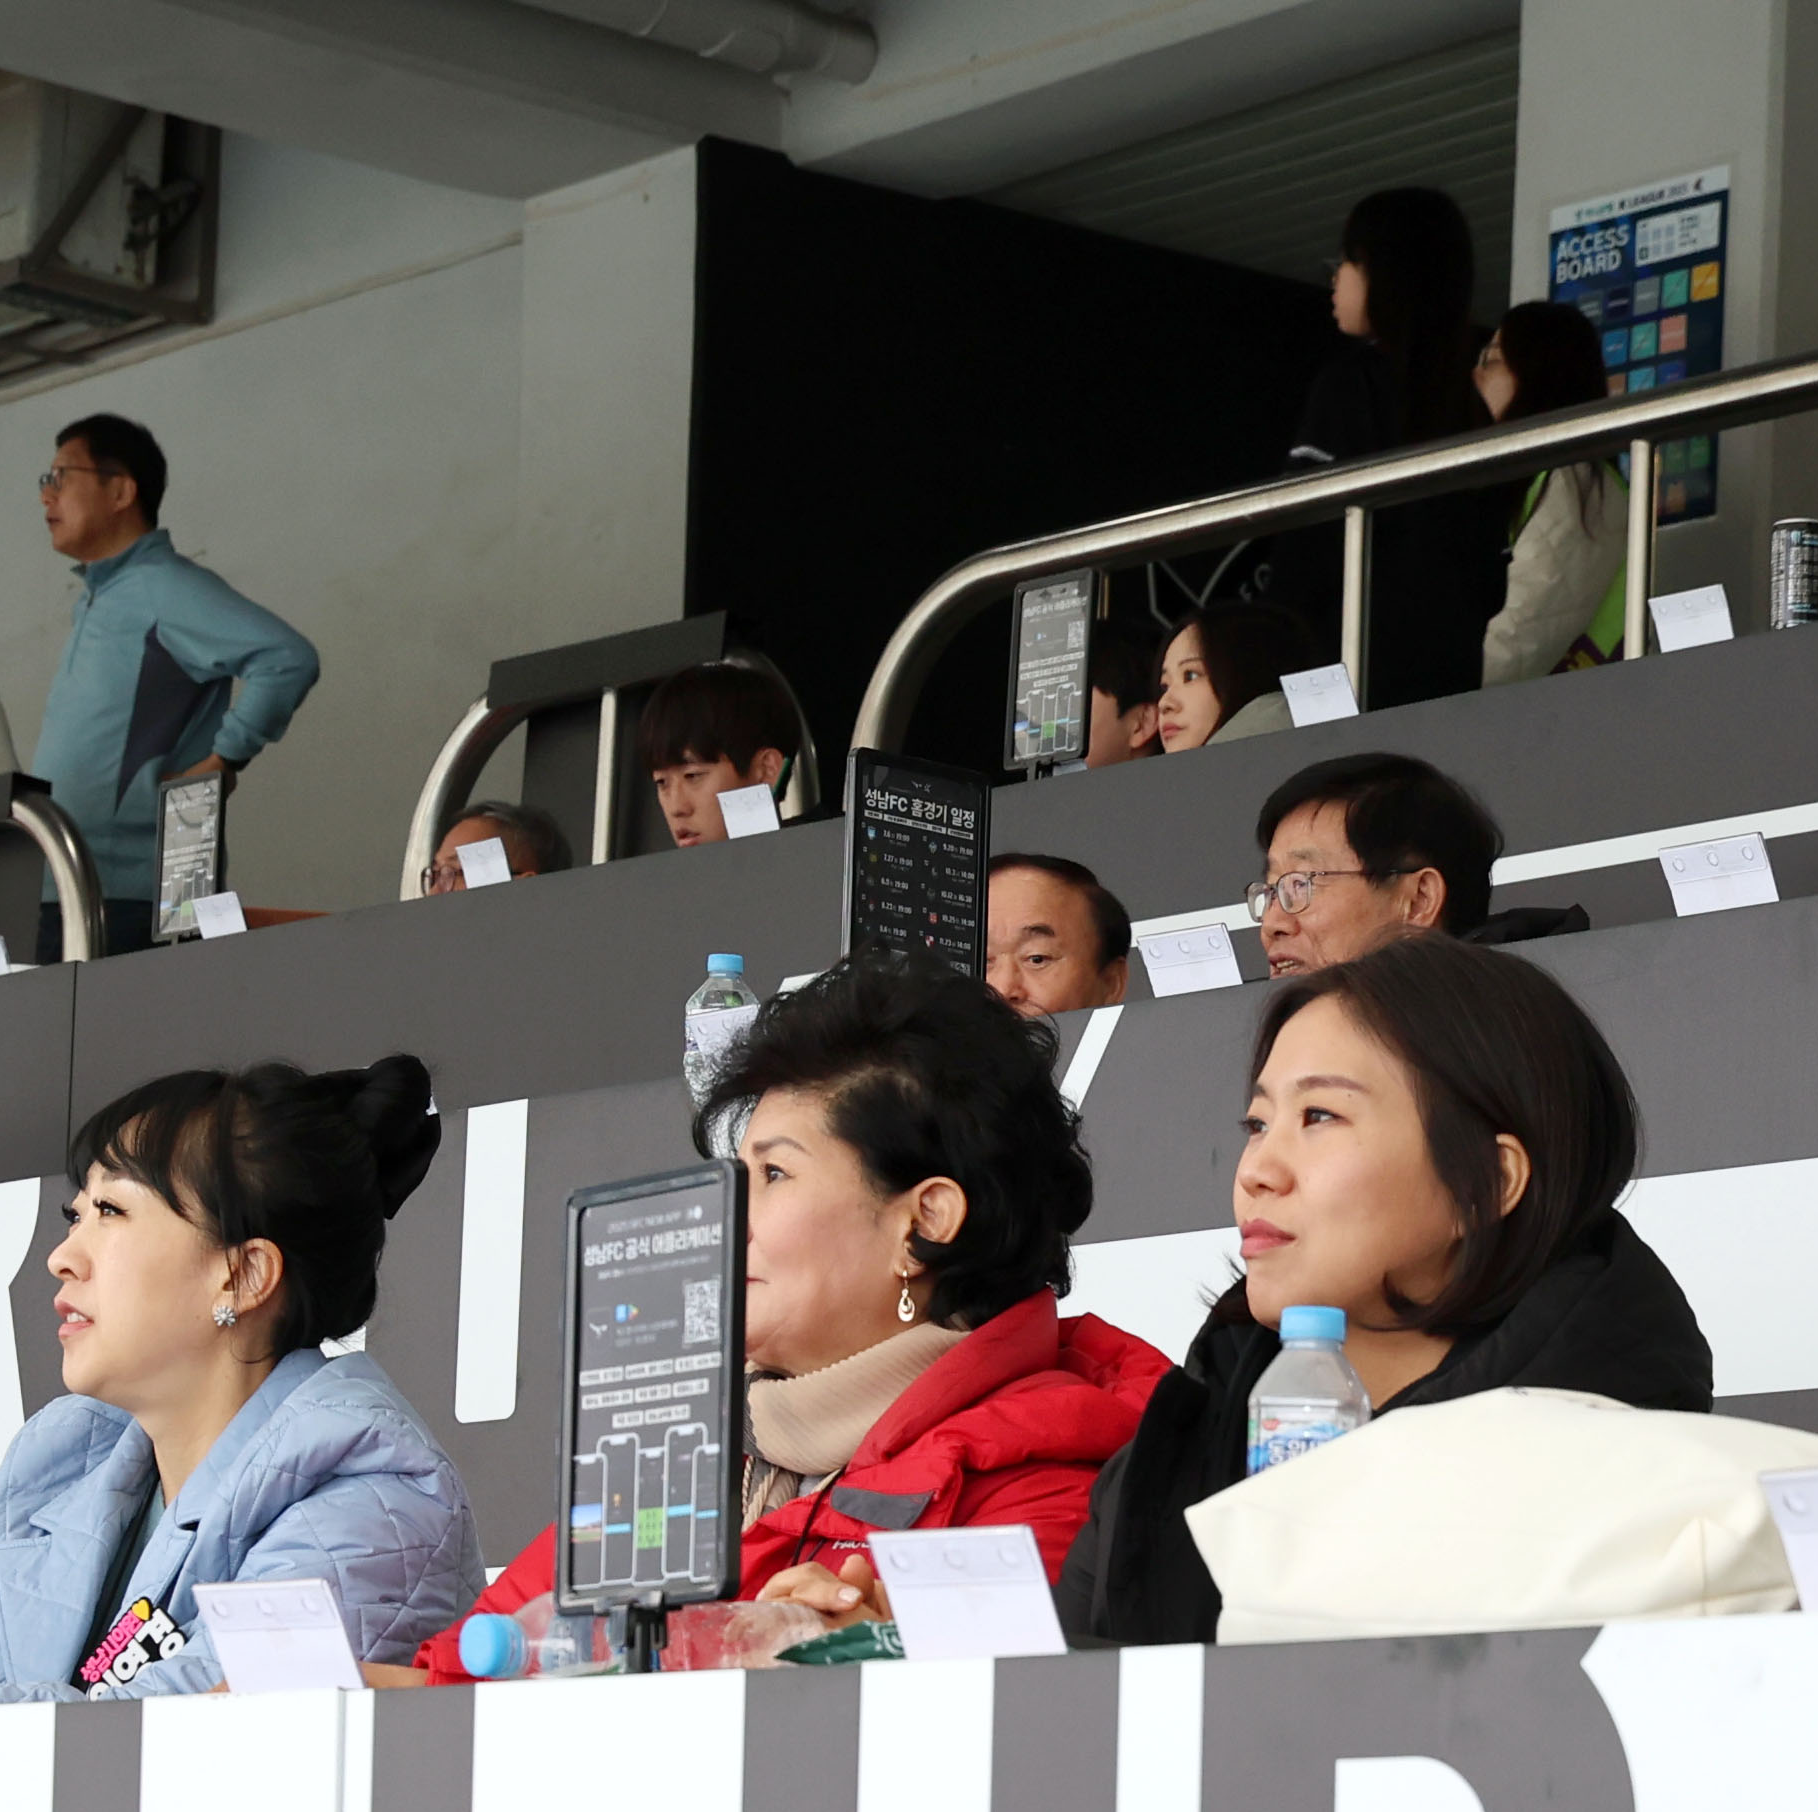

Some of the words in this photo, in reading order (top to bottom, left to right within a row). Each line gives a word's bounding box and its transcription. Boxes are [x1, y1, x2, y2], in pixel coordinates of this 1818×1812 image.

[1557, 224, 1630, 261] ACCESS
[1556, 250, 1622, 284] BOARD
[865, 788, 908, 812] 성남FC
[910, 798, 947, 824] 홈경기
[950, 807, 975, 829] 일정
[584, 1240, 624, 1267] 성남FC
[625, 1235, 651, 1260] 공식
[80, 1610, 144, 1683] 성남시의원
